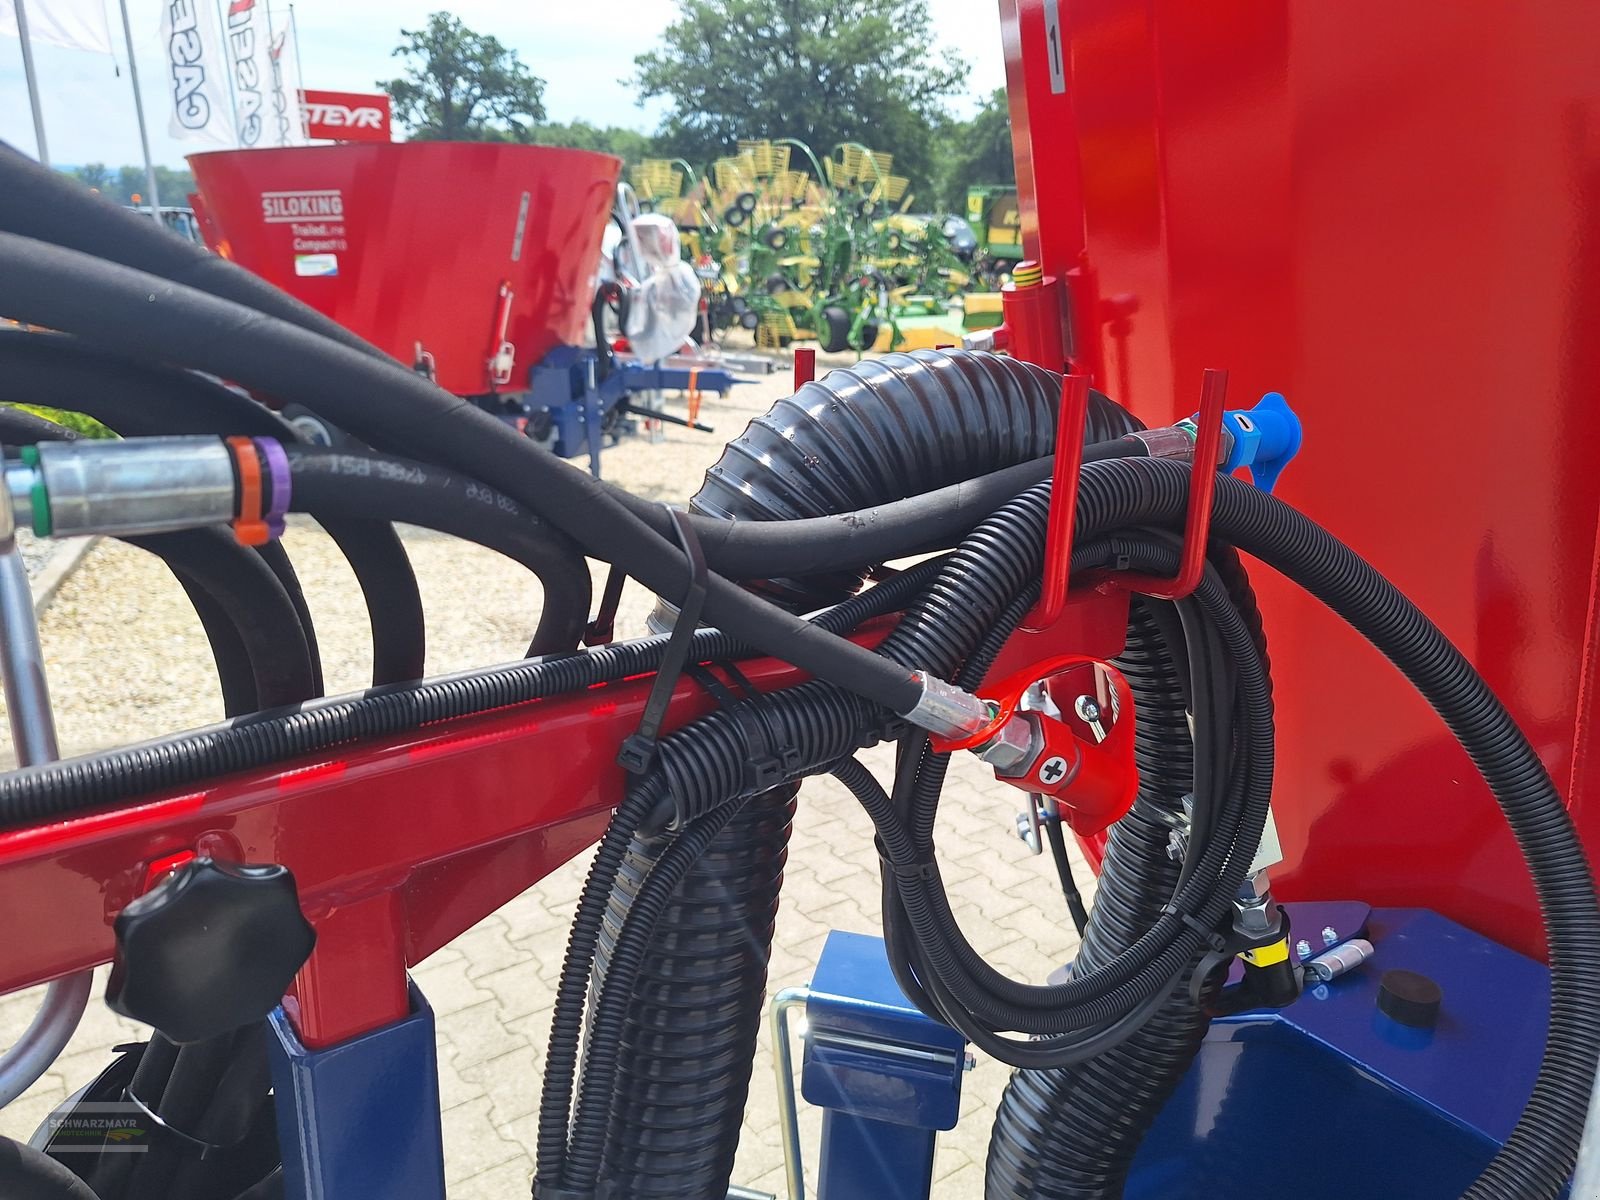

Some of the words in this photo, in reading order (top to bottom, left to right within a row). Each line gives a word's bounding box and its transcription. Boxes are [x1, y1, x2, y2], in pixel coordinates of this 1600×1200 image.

[1049, 24, 1060, 76] 1
[300, 103, 384, 130] STEYR
[261, 194, 344, 217] SILOKING
